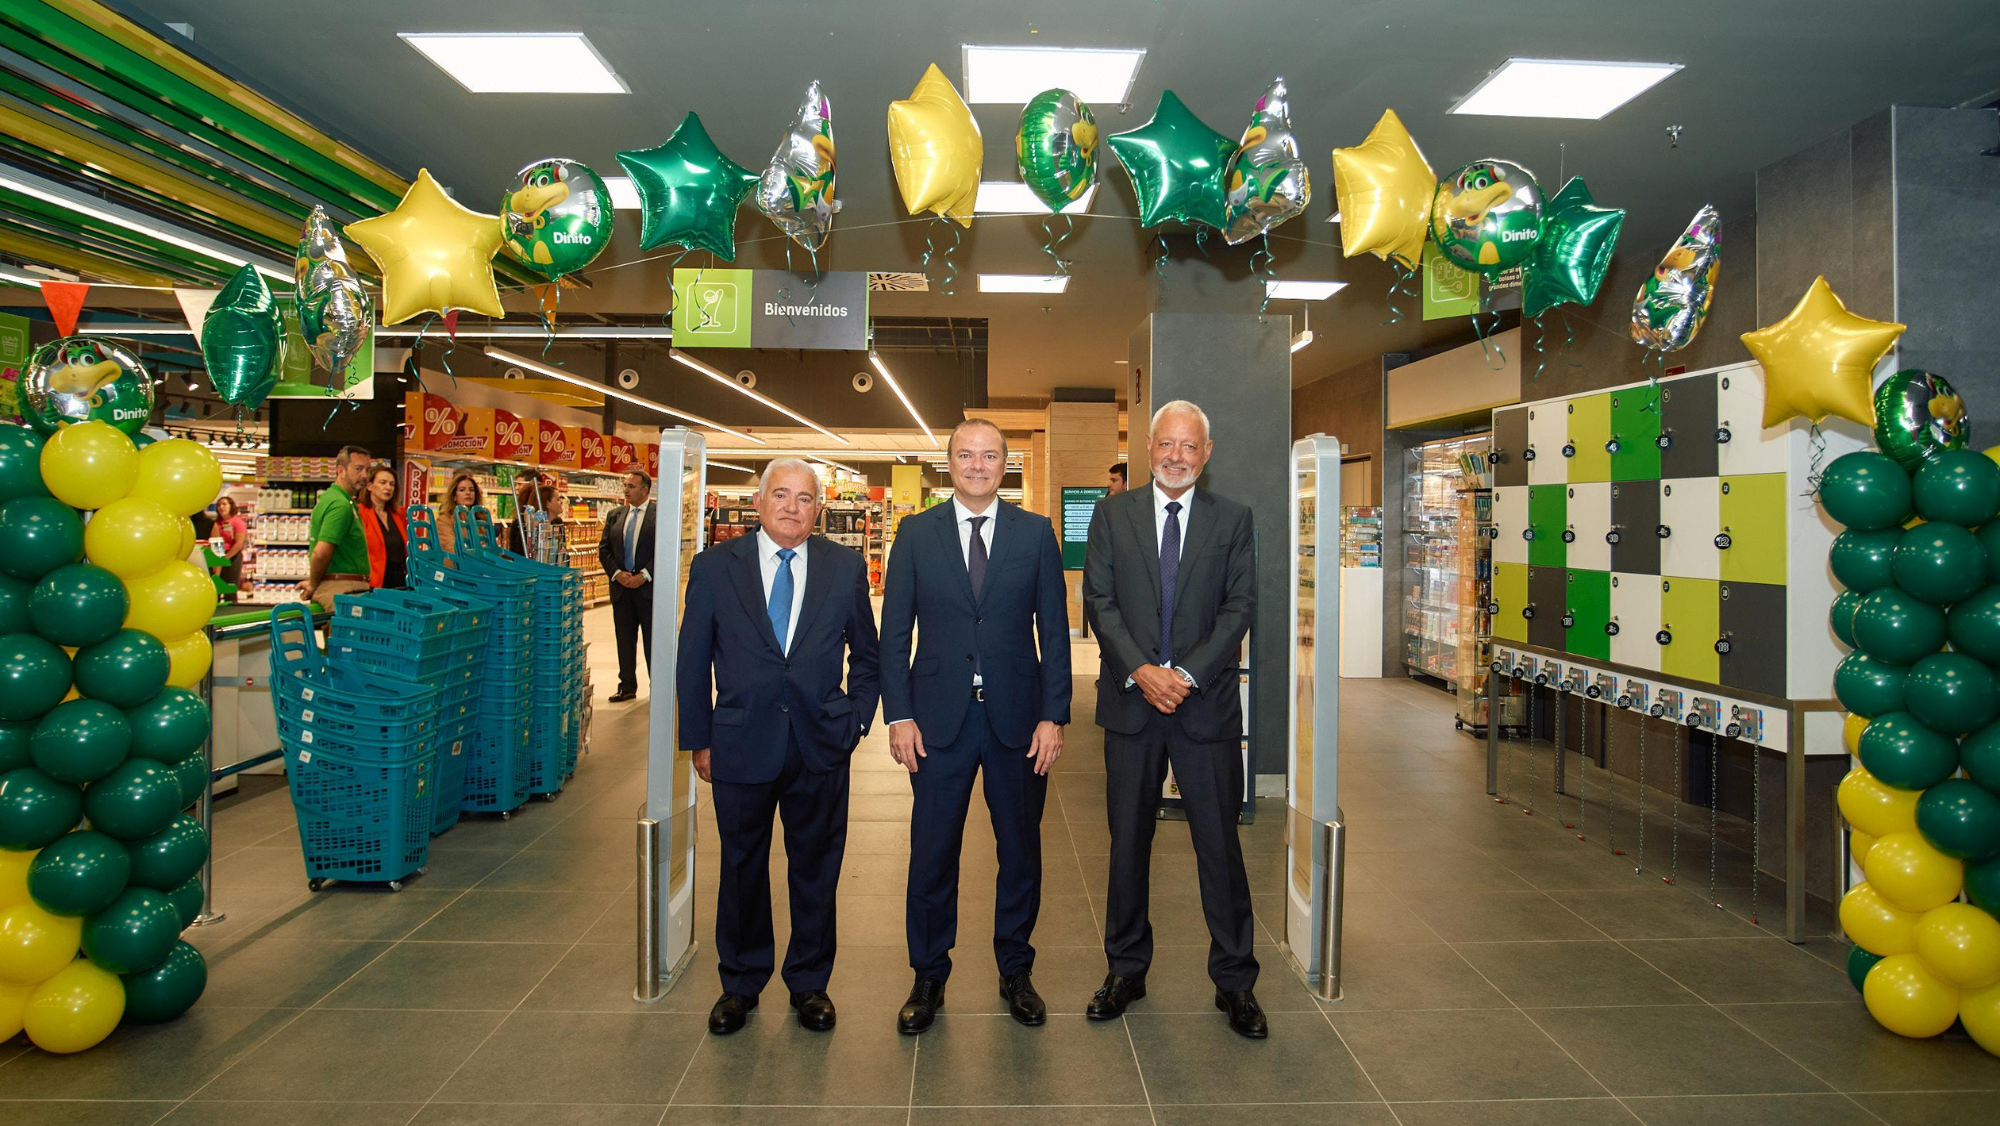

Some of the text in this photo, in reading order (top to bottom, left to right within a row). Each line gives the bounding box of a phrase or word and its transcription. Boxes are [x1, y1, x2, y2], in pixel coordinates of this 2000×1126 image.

[553, 231, 592, 245] Dinito
[1502, 228, 1537, 243] Dinito
[764, 302, 848, 318] Bienvenidos
[113, 408, 148, 420] Dinito
[443, 437, 483, 449] OMOCIÓN
[1717, 536, 1730, 547] 12
[1727, 726, 1740, 737] 27
